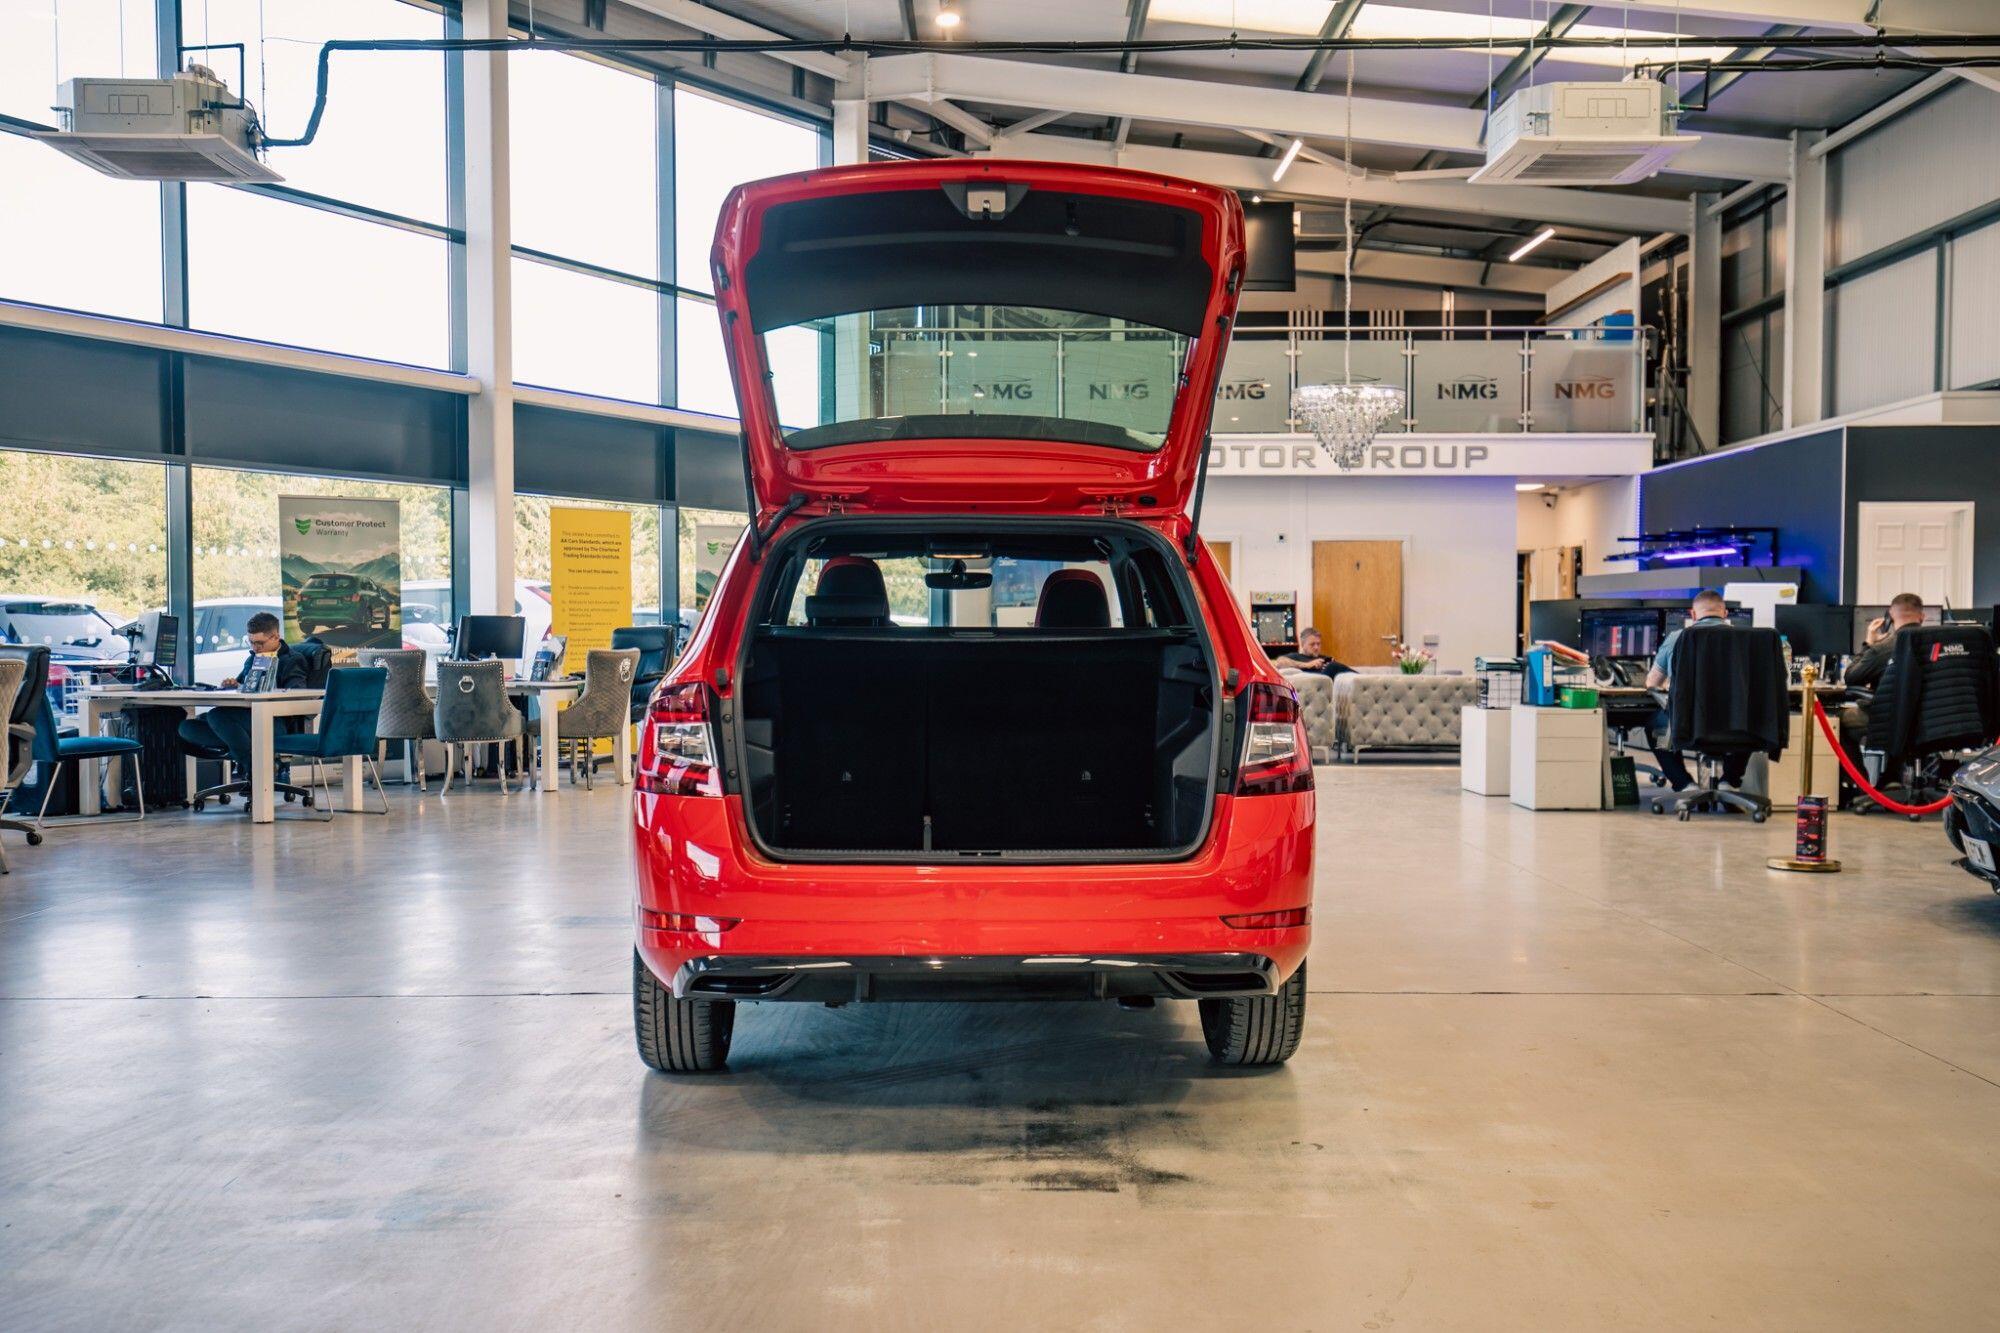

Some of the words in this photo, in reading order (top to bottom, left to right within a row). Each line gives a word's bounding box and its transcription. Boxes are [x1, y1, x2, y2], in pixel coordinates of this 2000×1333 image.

[973, 383, 1033, 400] NMG
[1089, 384, 1149, 400] NMG
[1437, 382, 1499, 400] NMG
[1554, 382, 1616, 400] NMG
[1208, 445, 1317, 468] OTOR
[315, 519, 355, 528] Customer
[356, 520, 386, 528] Protect
[316, 529, 349, 537] Warranty
[1612, 773, 1631, 783] M&S
